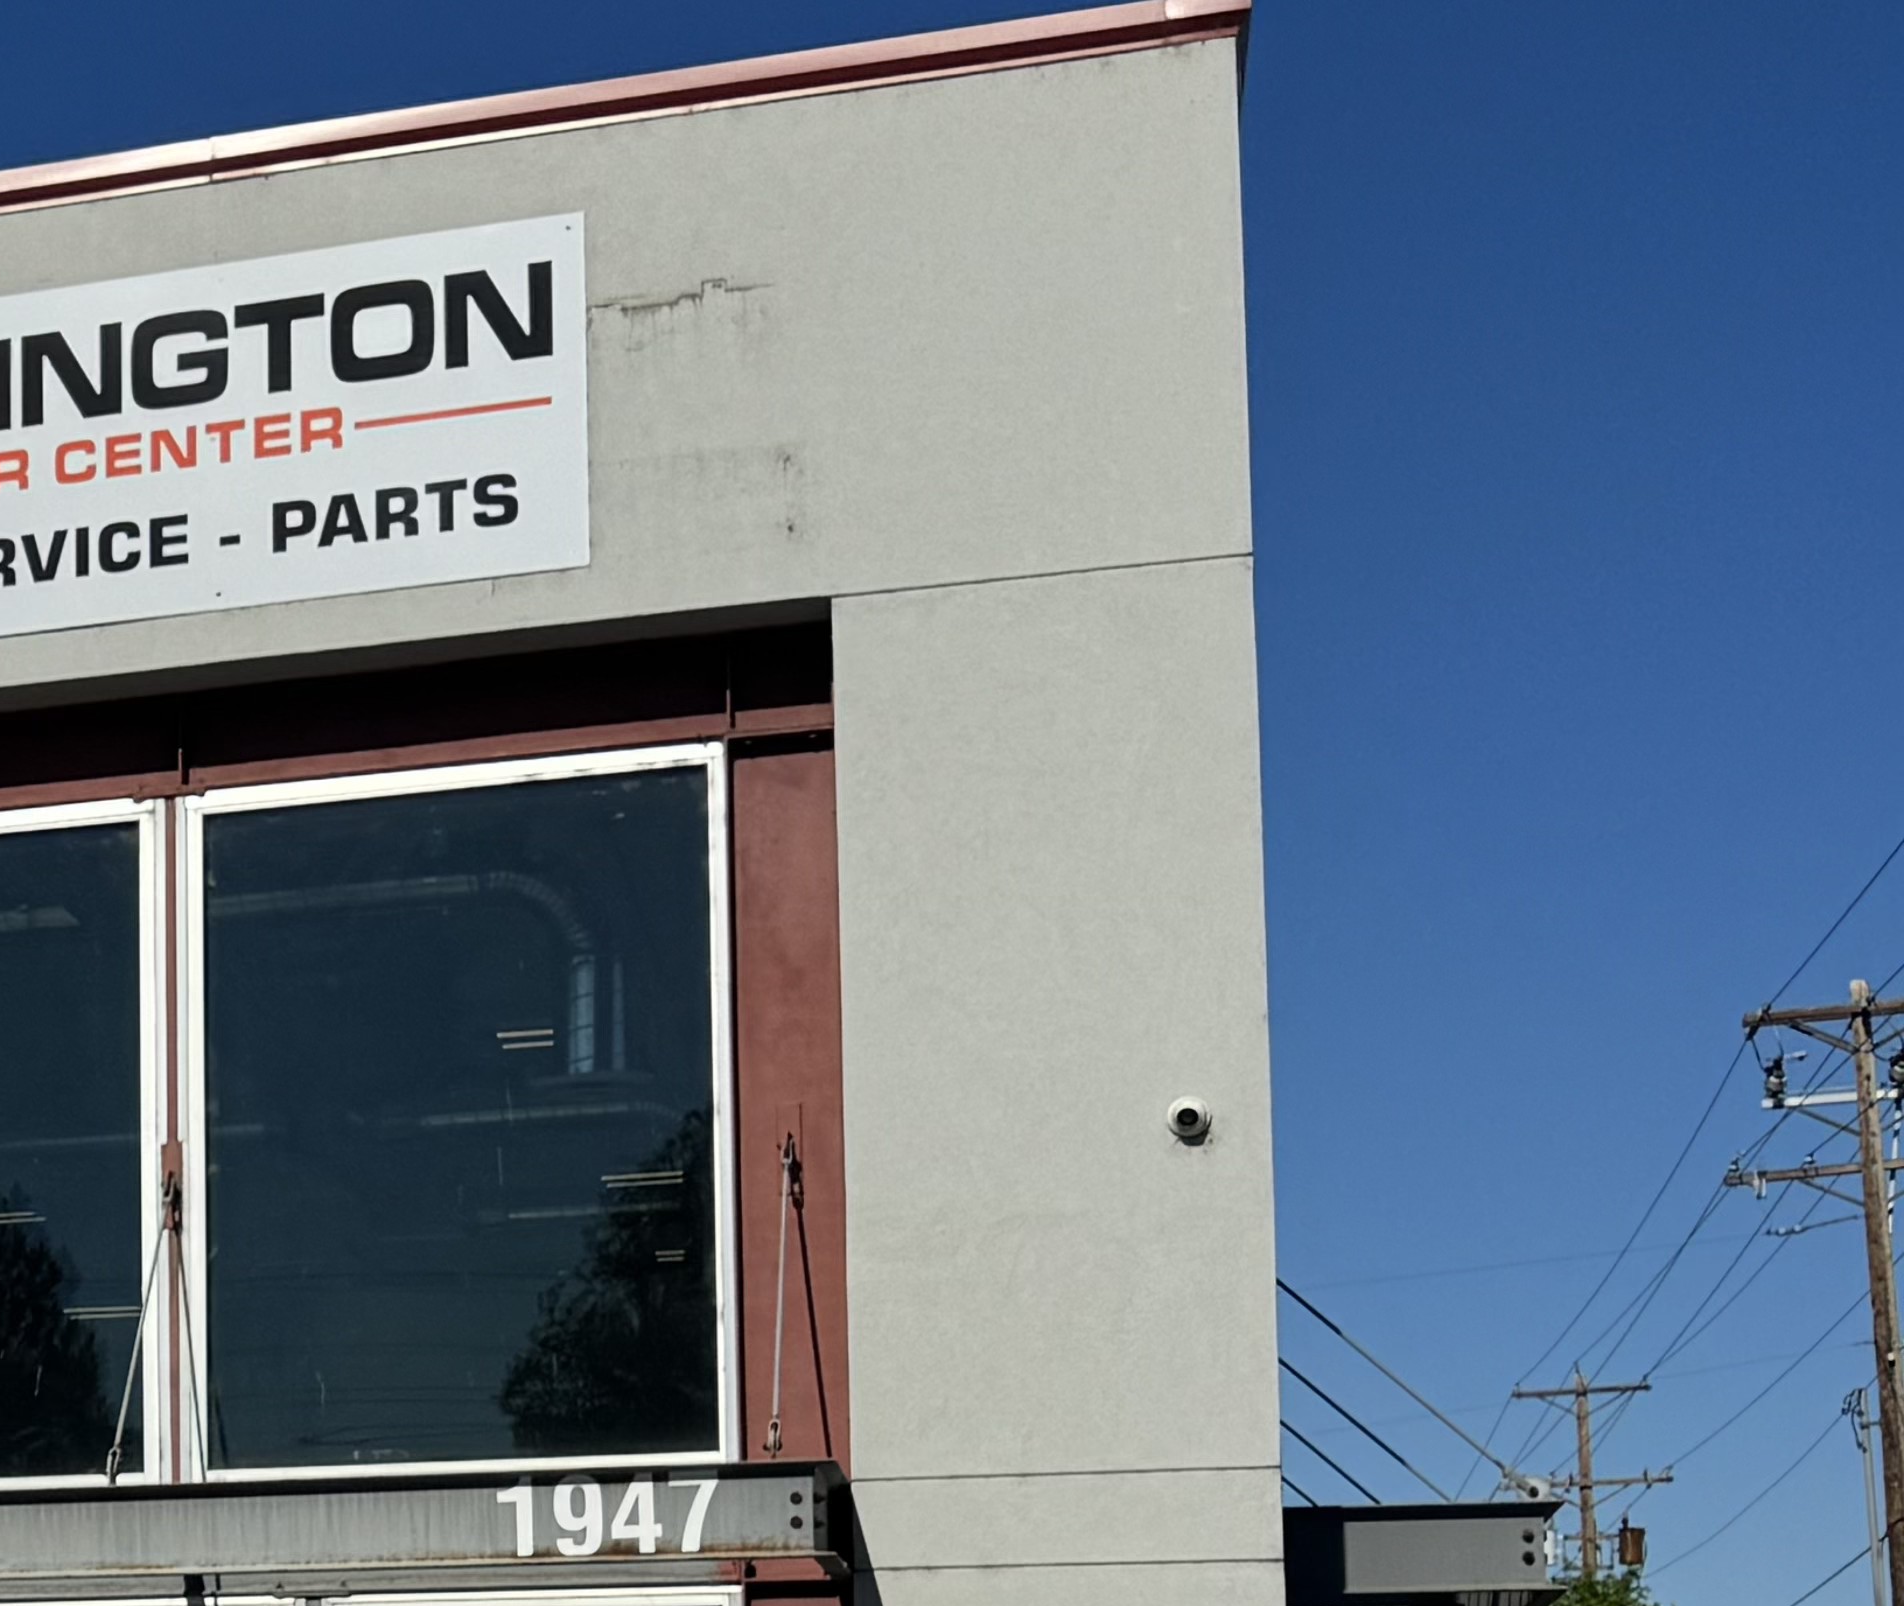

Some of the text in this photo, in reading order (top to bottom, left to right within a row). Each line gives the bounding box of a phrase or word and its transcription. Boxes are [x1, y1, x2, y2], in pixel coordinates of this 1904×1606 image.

[56, 408, 343, 485] CENTER
[272, 473, 519, 553] PARTS
[496, 1472, 719, 1557] 1947
